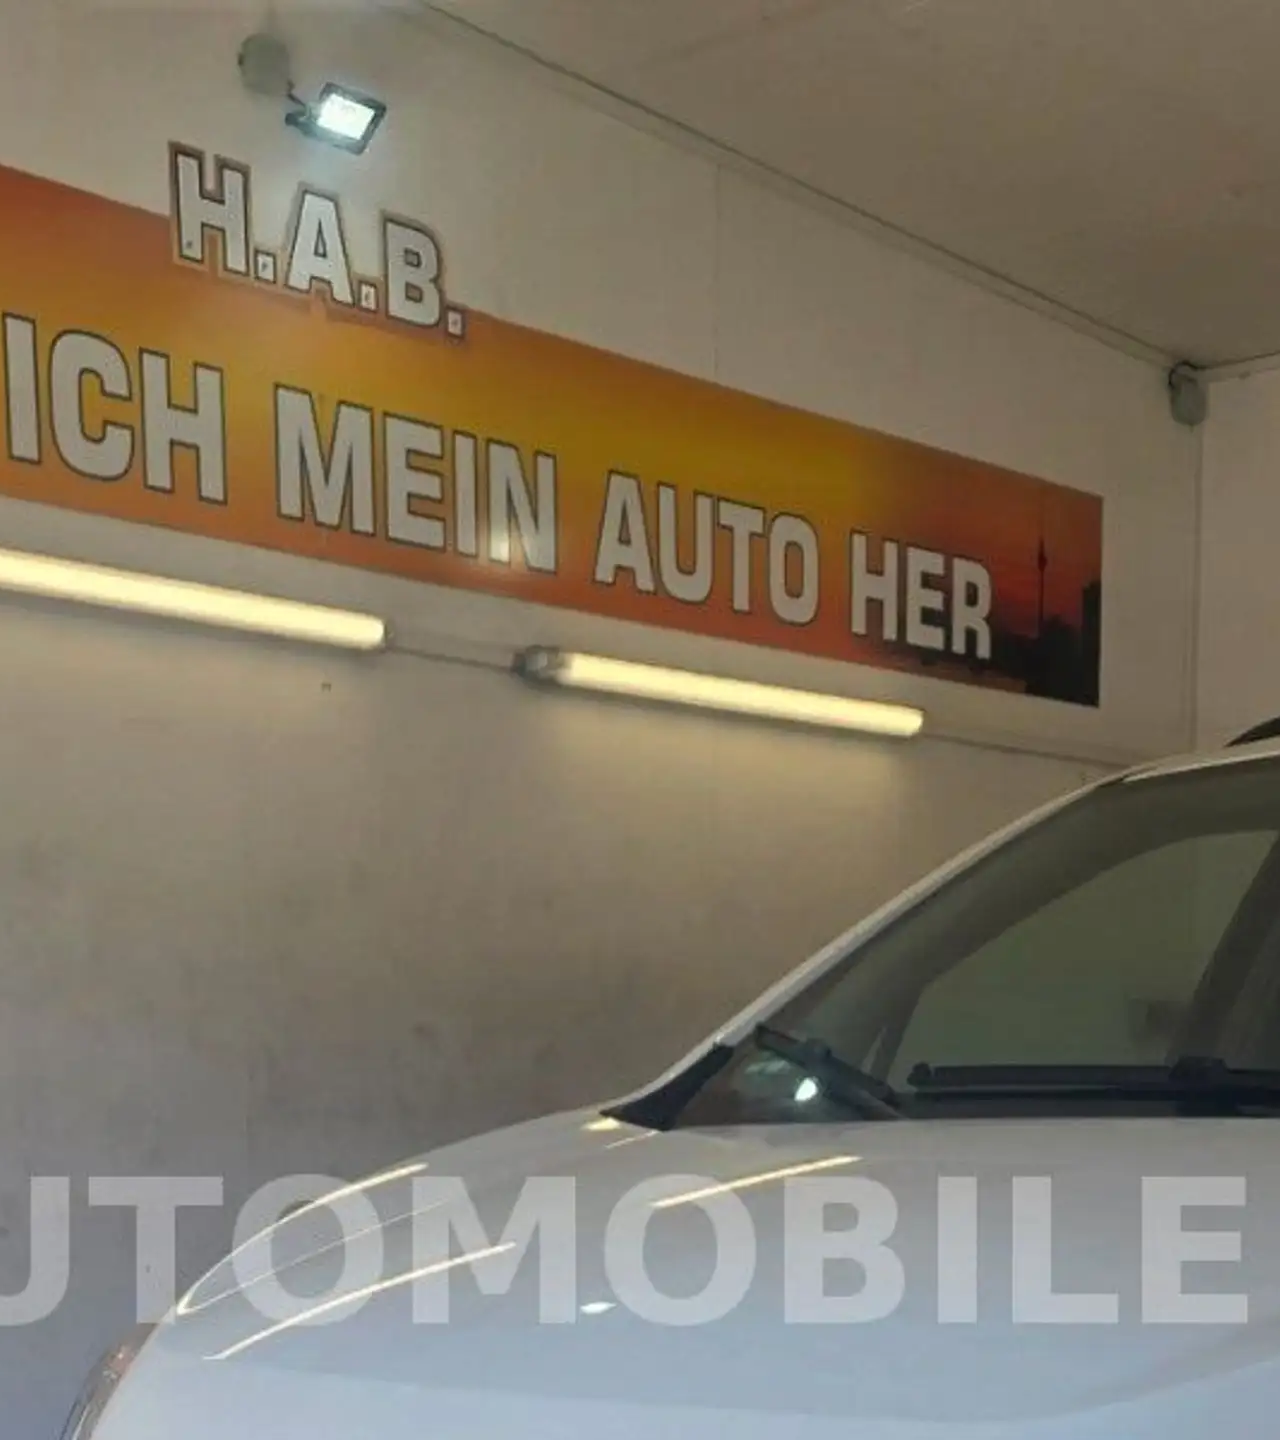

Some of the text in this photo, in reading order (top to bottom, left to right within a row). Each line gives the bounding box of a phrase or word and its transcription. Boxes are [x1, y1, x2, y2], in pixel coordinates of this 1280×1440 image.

[168, 142, 468, 340] H.A.B.
[2, 312, 227, 505] ICH
[274, 382, 557, 574] MEIN
[595, 470, 820, 627] AUTO
[850, 531, 993, 660] HER
